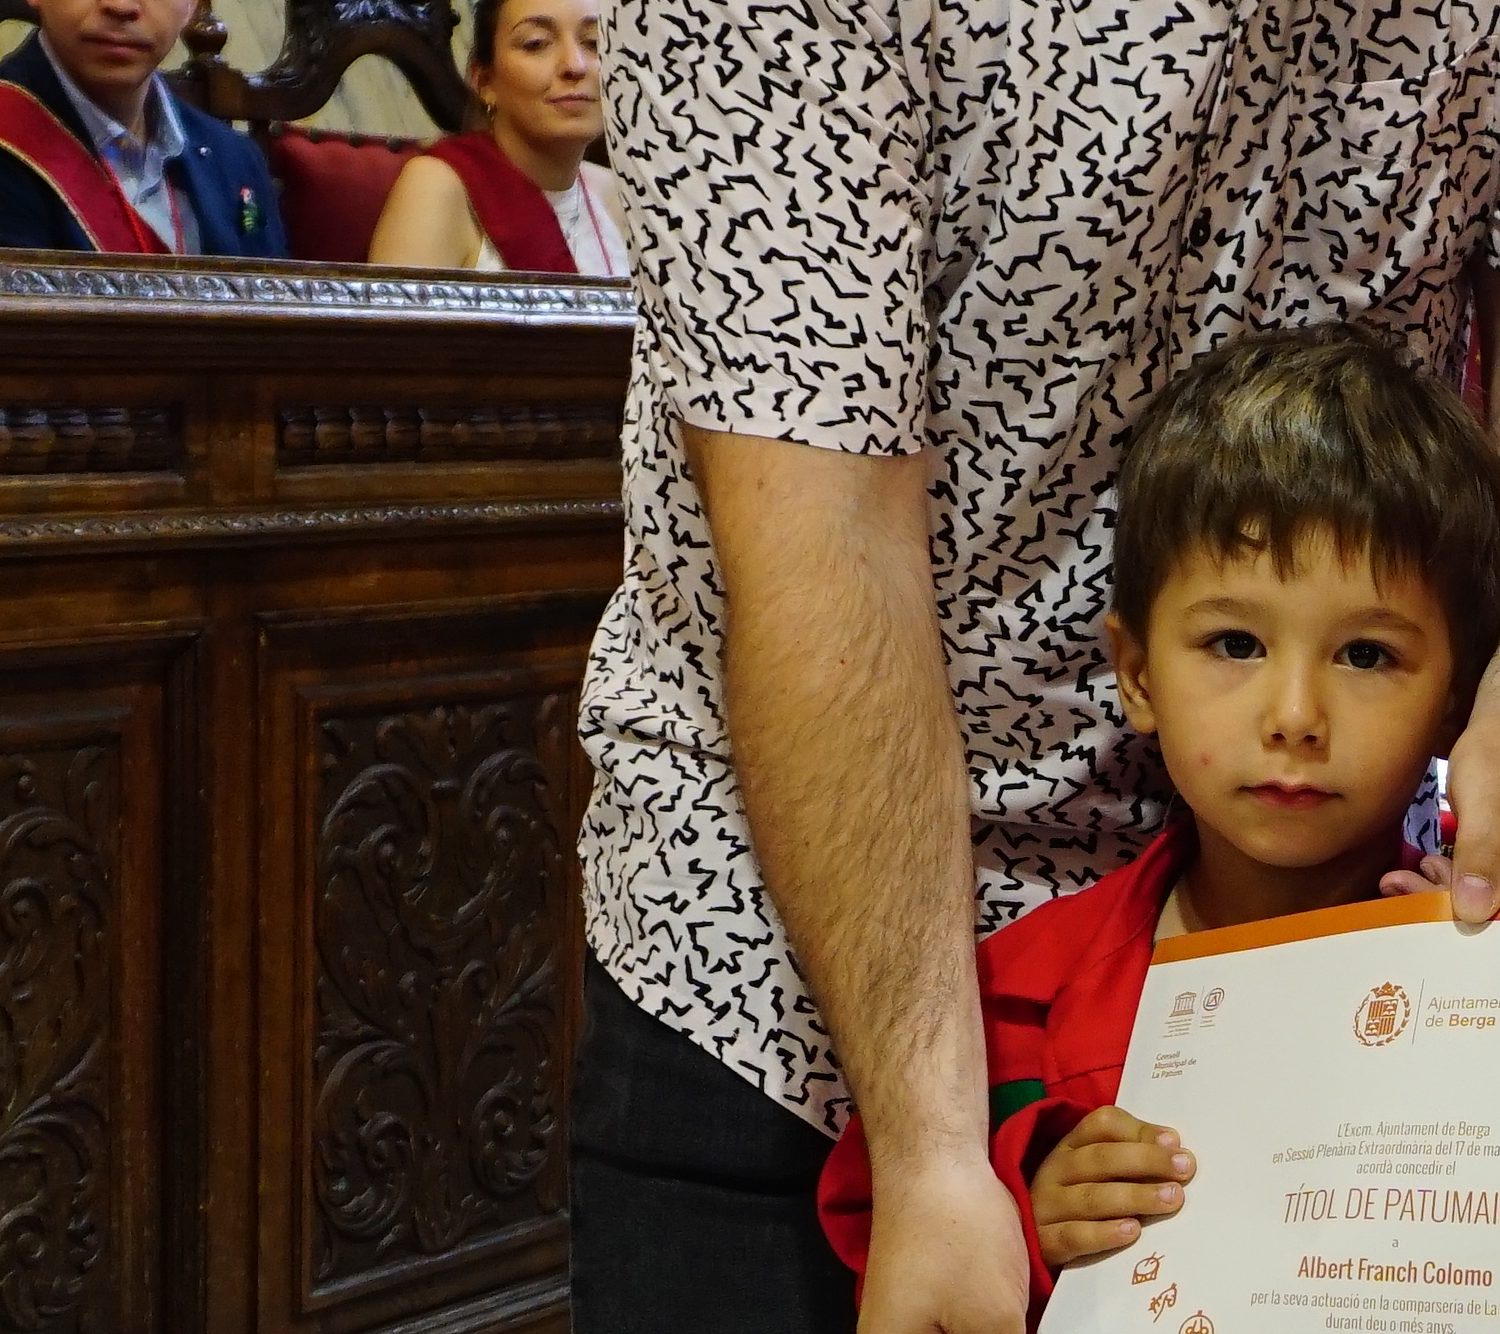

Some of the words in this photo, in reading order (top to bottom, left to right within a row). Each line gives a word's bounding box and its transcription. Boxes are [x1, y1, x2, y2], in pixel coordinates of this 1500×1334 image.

[1425, 1015, 1443, 1027] de
[1448, 1014, 1496, 1029] Berga
[1188, 1058, 1197, 1066] de
[1161, 1070, 1183, 1078] Patum
[1376, 1121, 1439, 1138] Ajuntament
[1442, 1121, 1455, 1136] de
[1458, 1121, 1491, 1139] Berga
[1272, 1152, 1283, 1164] en
[1285, 1147, 1315, 1162] Sessió
[1316, 1143, 1356, 1159] Plenària
[1358, 1140, 1432, 1156] Extraordinària
[1435, 1140, 1452, 1156] del
[1455, 1141, 1465, 1156] 17
[1467, 1141, 1481, 1157] de
[1356, 1160, 1392, 1175] acordà
[1395, 1161, 1443, 1176] concedir
[1445, 1161, 1456, 1176] el
[1284, 1183, 1338, 1223] TÍTOL
[1345, 1188, 1379, 1220] DE
[1392, 1239, 1399, 1248] a
[1297, 1255, 1353, 1280] Albert
[1358, 1258, 1417, 1283] Franch
[1423, 1261, 1493, 1287] Colomo
[1250, 1292, 1269, 1306] per
[1271, 1290, 1280, 1305] la
[1283, 1293, 1308, 1306] seva
[1311, 1293, 1360, 1309] actuació
[1363, 1297, 1376, 1310] en
[1379, 1294, 1389, 1310] la
[1392, 1298, 1463, 1315] comparseria
[1467, 1300, 1481, 1315] de
[1484, 1300, 1497, 1316] La
[1325, 1313, 1362, 1330] durant
[1365, 1315, 1386, 1331] deu
[1389, 1320, 1396, 1332] o
[1400, 1317, 1423, 1333] més
